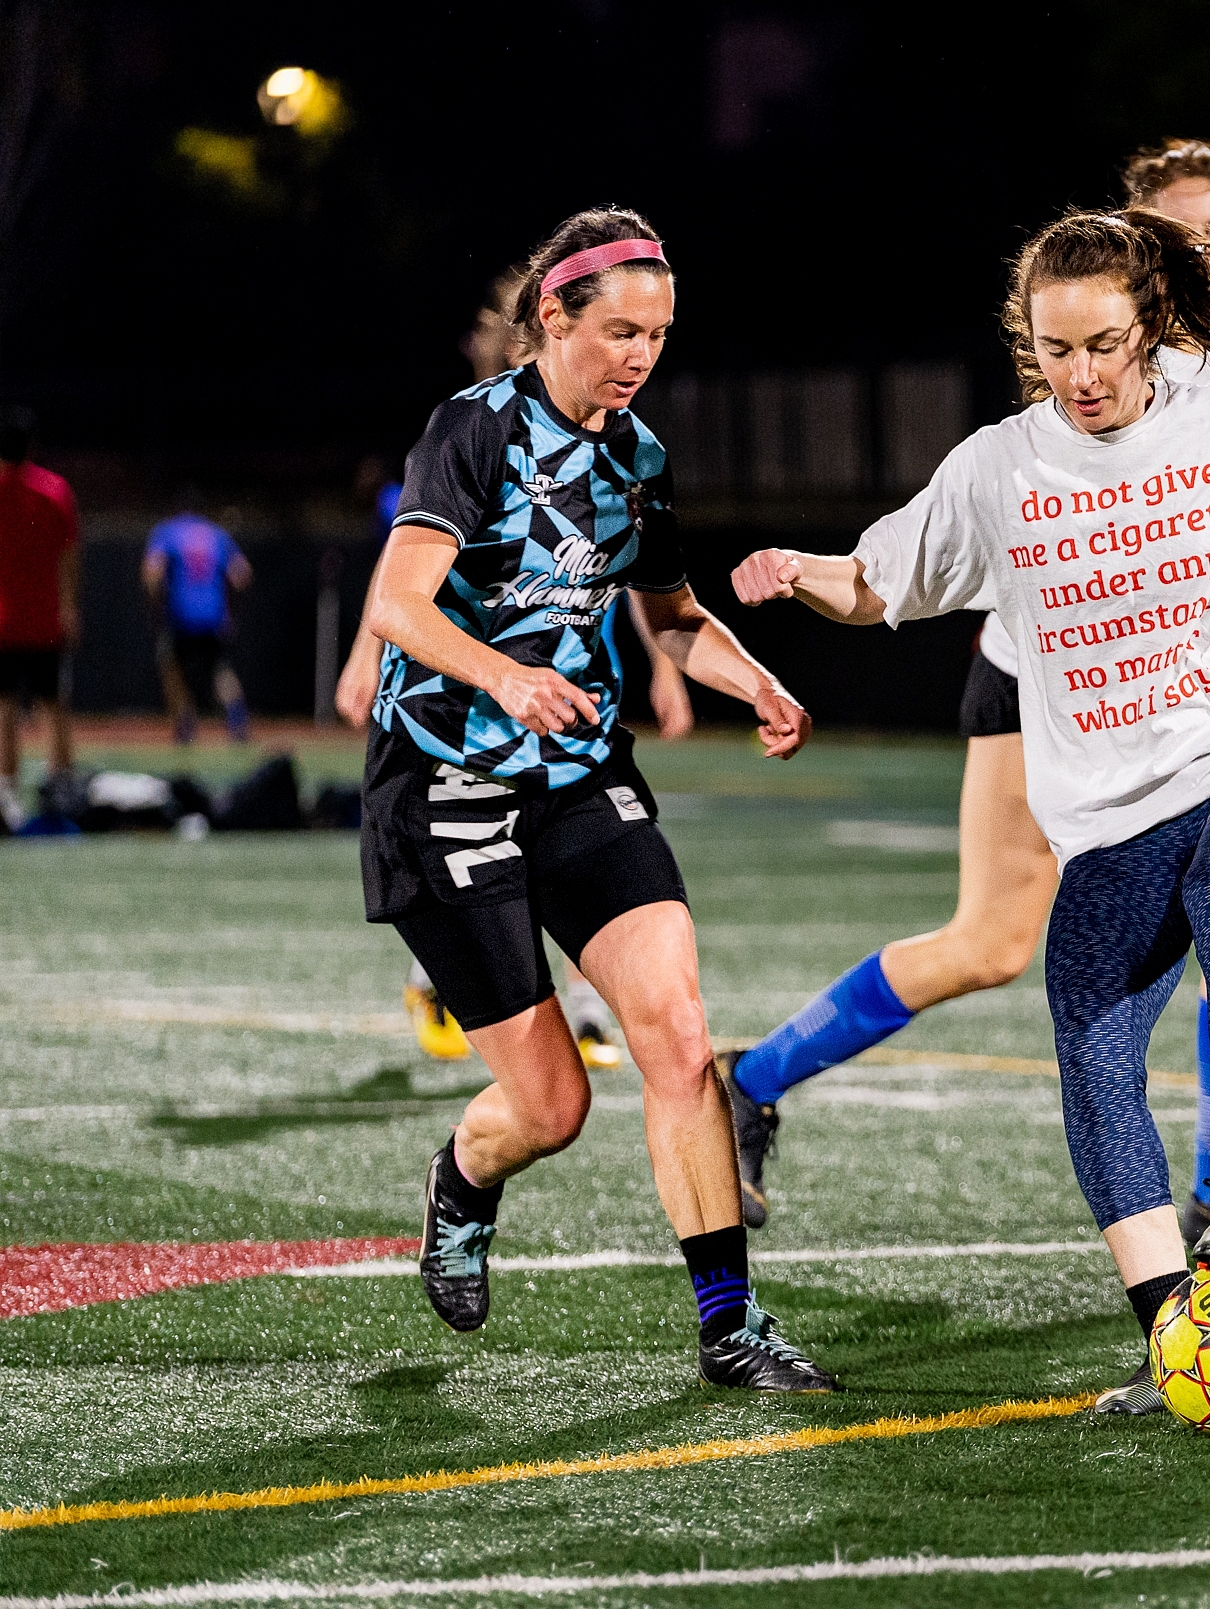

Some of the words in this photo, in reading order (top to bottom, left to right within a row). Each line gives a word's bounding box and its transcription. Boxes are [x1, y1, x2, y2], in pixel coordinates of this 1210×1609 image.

[1021, 491, 1062, 522] do
[1071, 481, 1133, 514] not
[553, 535, 611, 585] Mia
[1008, 542, 1048, 568] me
[1057, 537, 1080, 562] a
[1041, 569, 1146, 609] under
[1064, 666, 1107, 691] no
[1147, 686, 1157, 715] i
[693, 1266, 738, 1289] ATL
